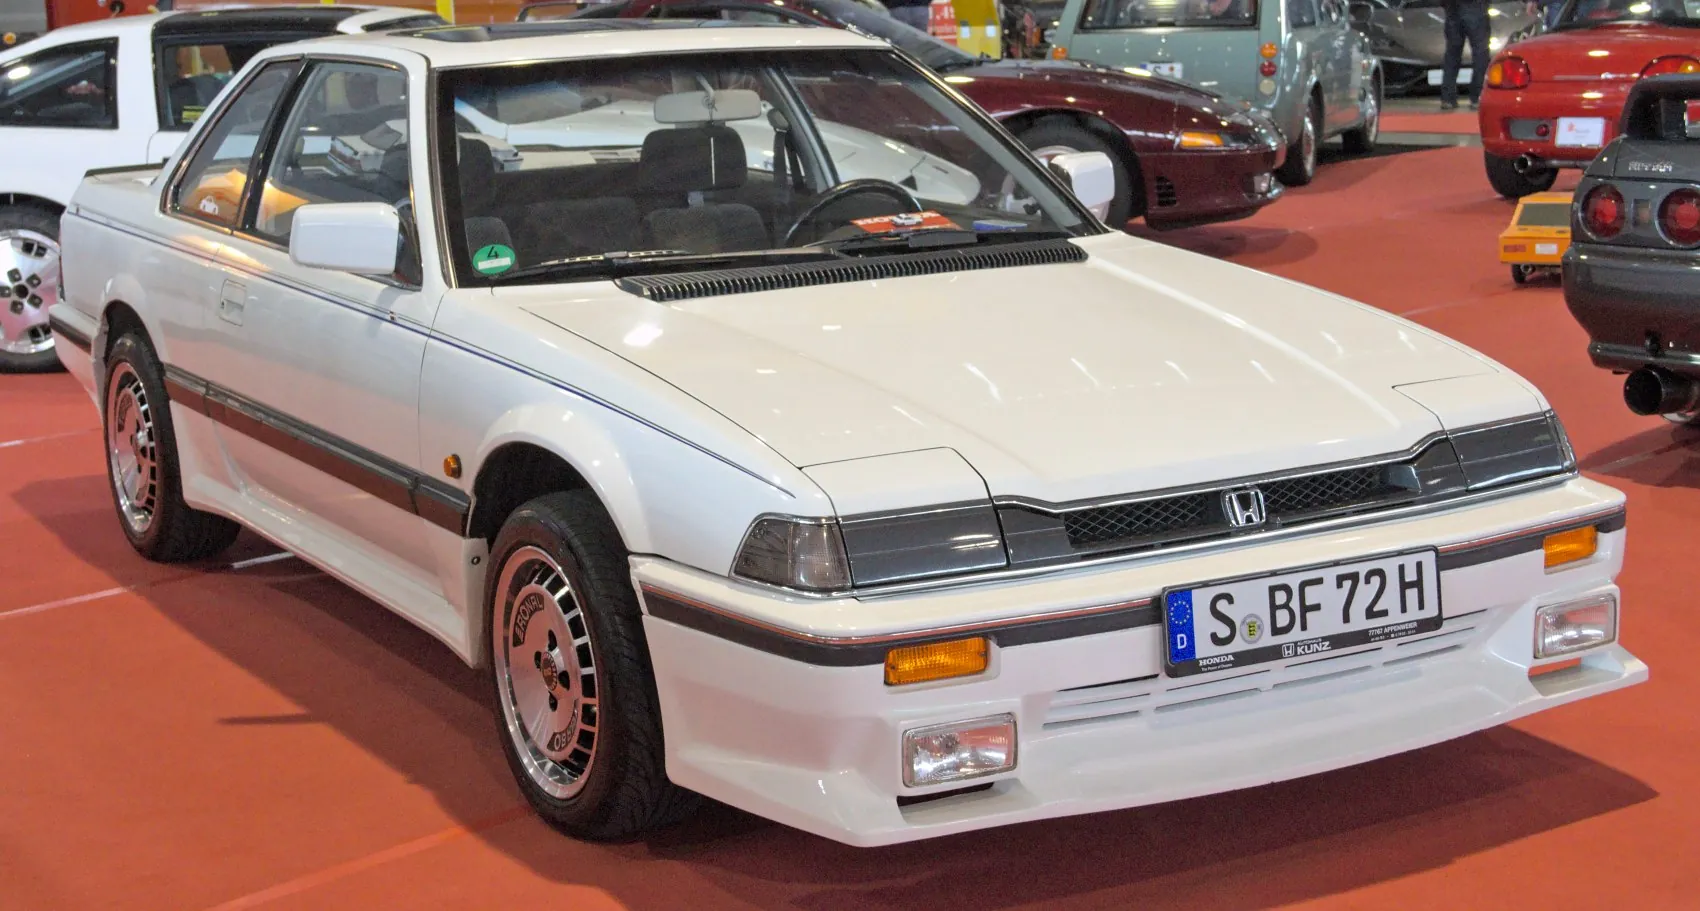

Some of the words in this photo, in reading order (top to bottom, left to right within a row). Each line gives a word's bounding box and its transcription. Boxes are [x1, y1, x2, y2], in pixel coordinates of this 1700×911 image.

[487, 245, 499, 259] 4
[1209, 592, 1237, 647] S
[1268, 577, 1324, 637] BF
[1177, 634, 1187, 650] D
[1199, 654, 1235, 666] HONDA
